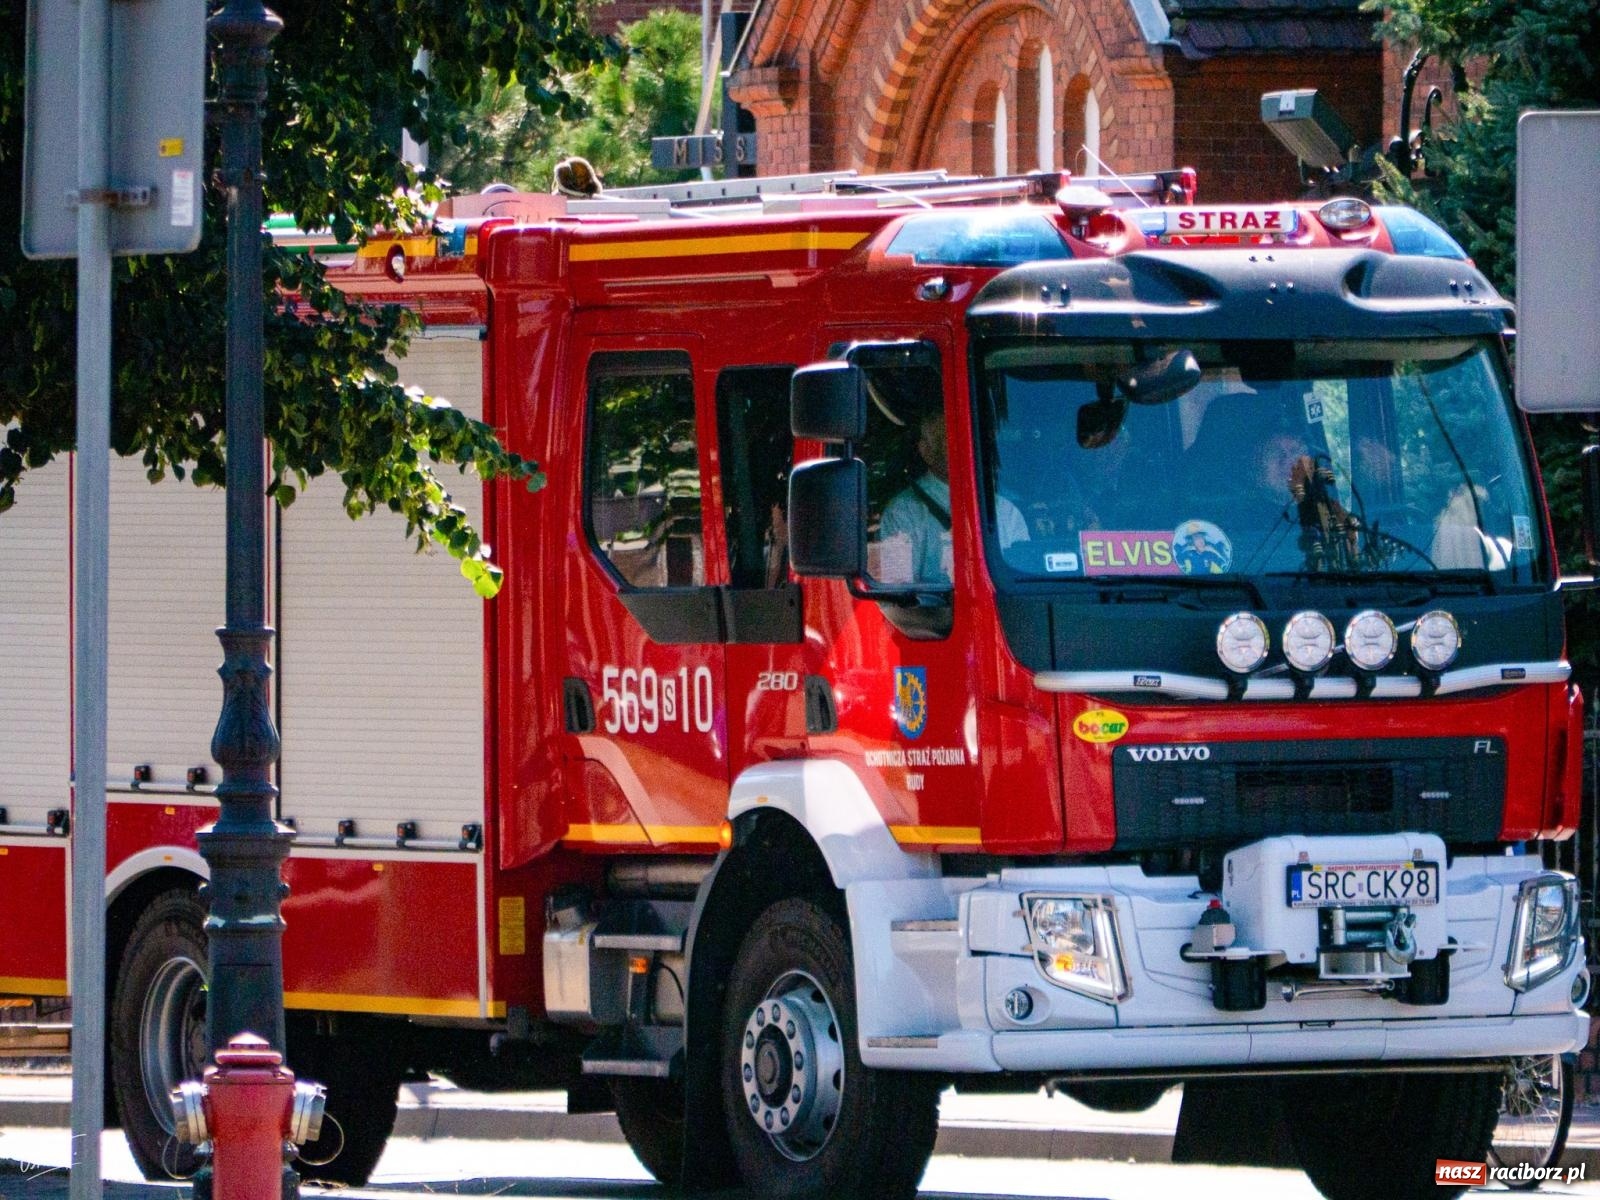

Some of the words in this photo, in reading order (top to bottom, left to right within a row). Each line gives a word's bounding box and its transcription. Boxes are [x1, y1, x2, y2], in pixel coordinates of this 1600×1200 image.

[1086, 540, 1172, 567] ELVIS
[757, 671, 799, 691] 280
[907, 746, 931, 767] STRAŻ
[931, 746, 966, 766] POŻARNA
[1127, 746, 1210, 762] VOLVO
[1473, 740, 1498, 754] FL
[1291, 889, 1301, 898] PL
[1307, 872, 1357, 899] SRC
[1366, 869, 1430, 899] CK98
